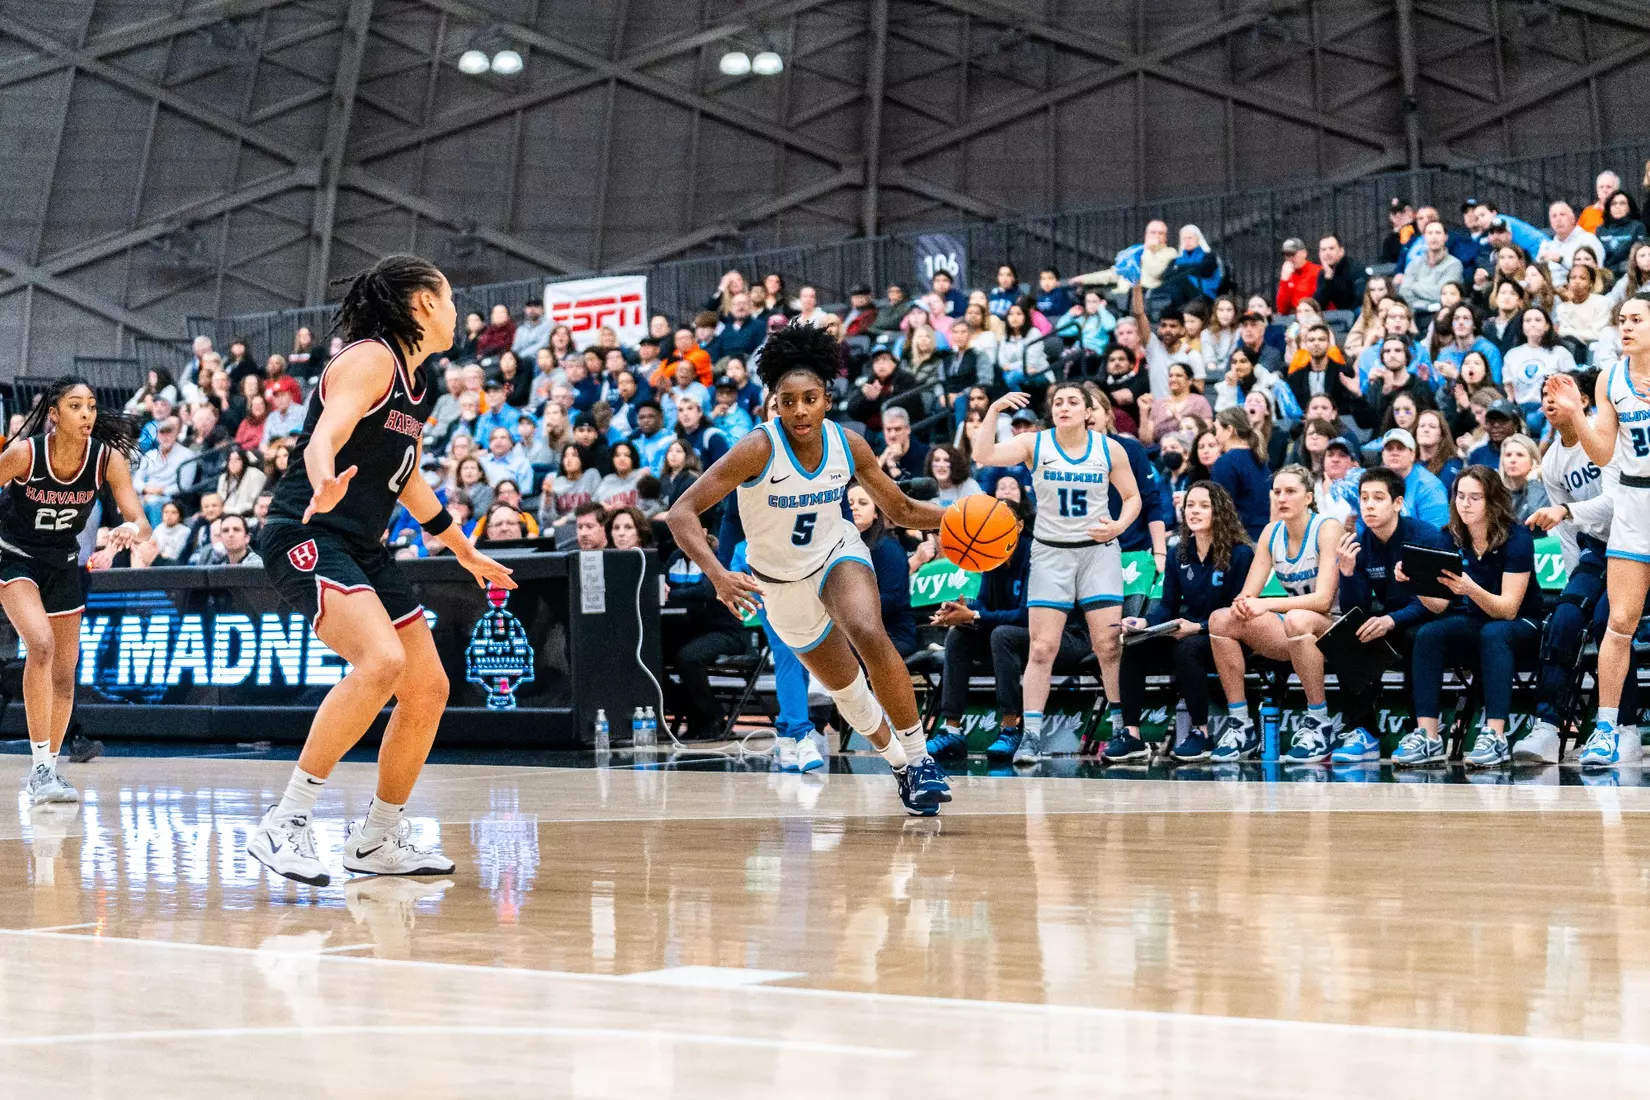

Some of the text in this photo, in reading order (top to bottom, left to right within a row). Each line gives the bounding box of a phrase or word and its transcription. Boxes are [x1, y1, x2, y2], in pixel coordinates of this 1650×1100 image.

[924, 253, 959, 278] 106
[552, 293, 642, 332] ESPN
[1629, 426, 1650, 457] 2
[388, 444, 415, 493] 0
[1560, 461, 1602, 493] IONS
[1057, 487, 1088, 517] 15
[35, 507, 79, 530] 22
[790, 512, 818, 547] 5
[293, 544, 314, 567] H
[1534, 553, 1565, 582] vy
[116, 611, 437, 685] MADNE
[1378, 709, 1410, 733] Iv
